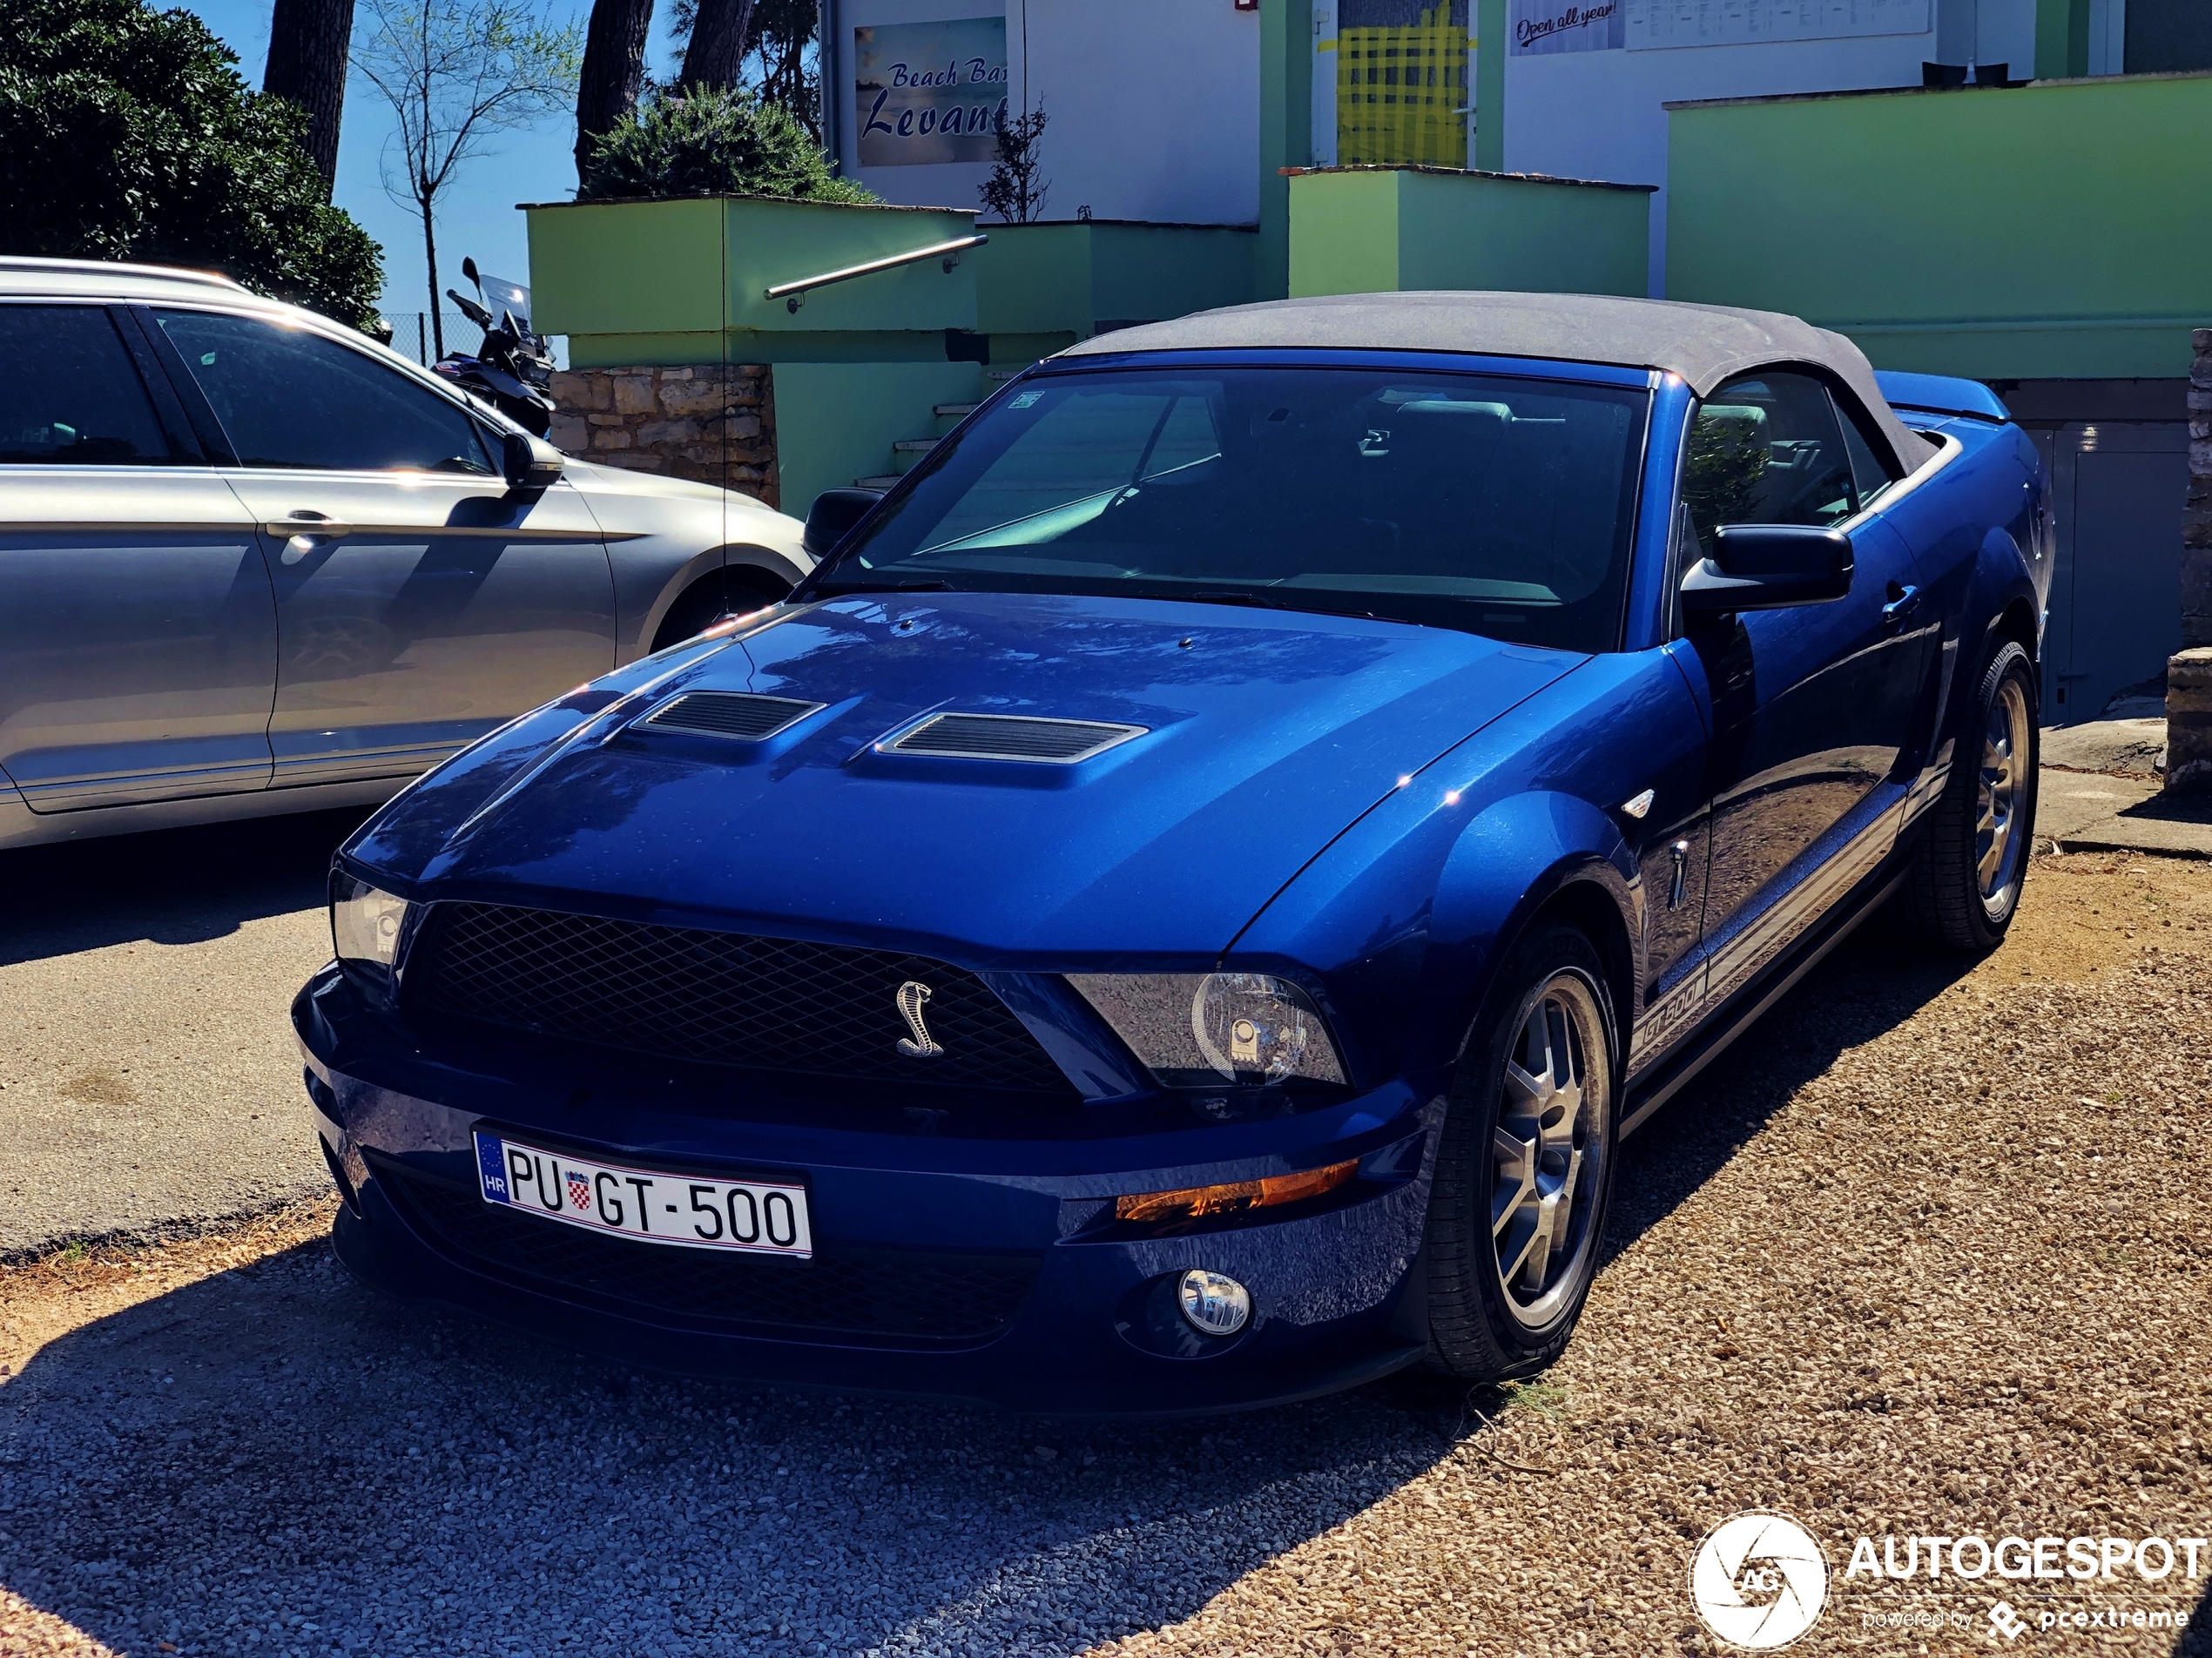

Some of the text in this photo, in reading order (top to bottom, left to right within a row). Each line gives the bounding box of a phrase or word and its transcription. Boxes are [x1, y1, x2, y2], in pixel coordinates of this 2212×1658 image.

[1516, 19, 1554, 40] Open
[1557, 7, 1579, 27] all
[887, 60, 958, 87] Beach
[485, 1175, 506, 1194] HR
[507, 1148, 563, 1212] PU
